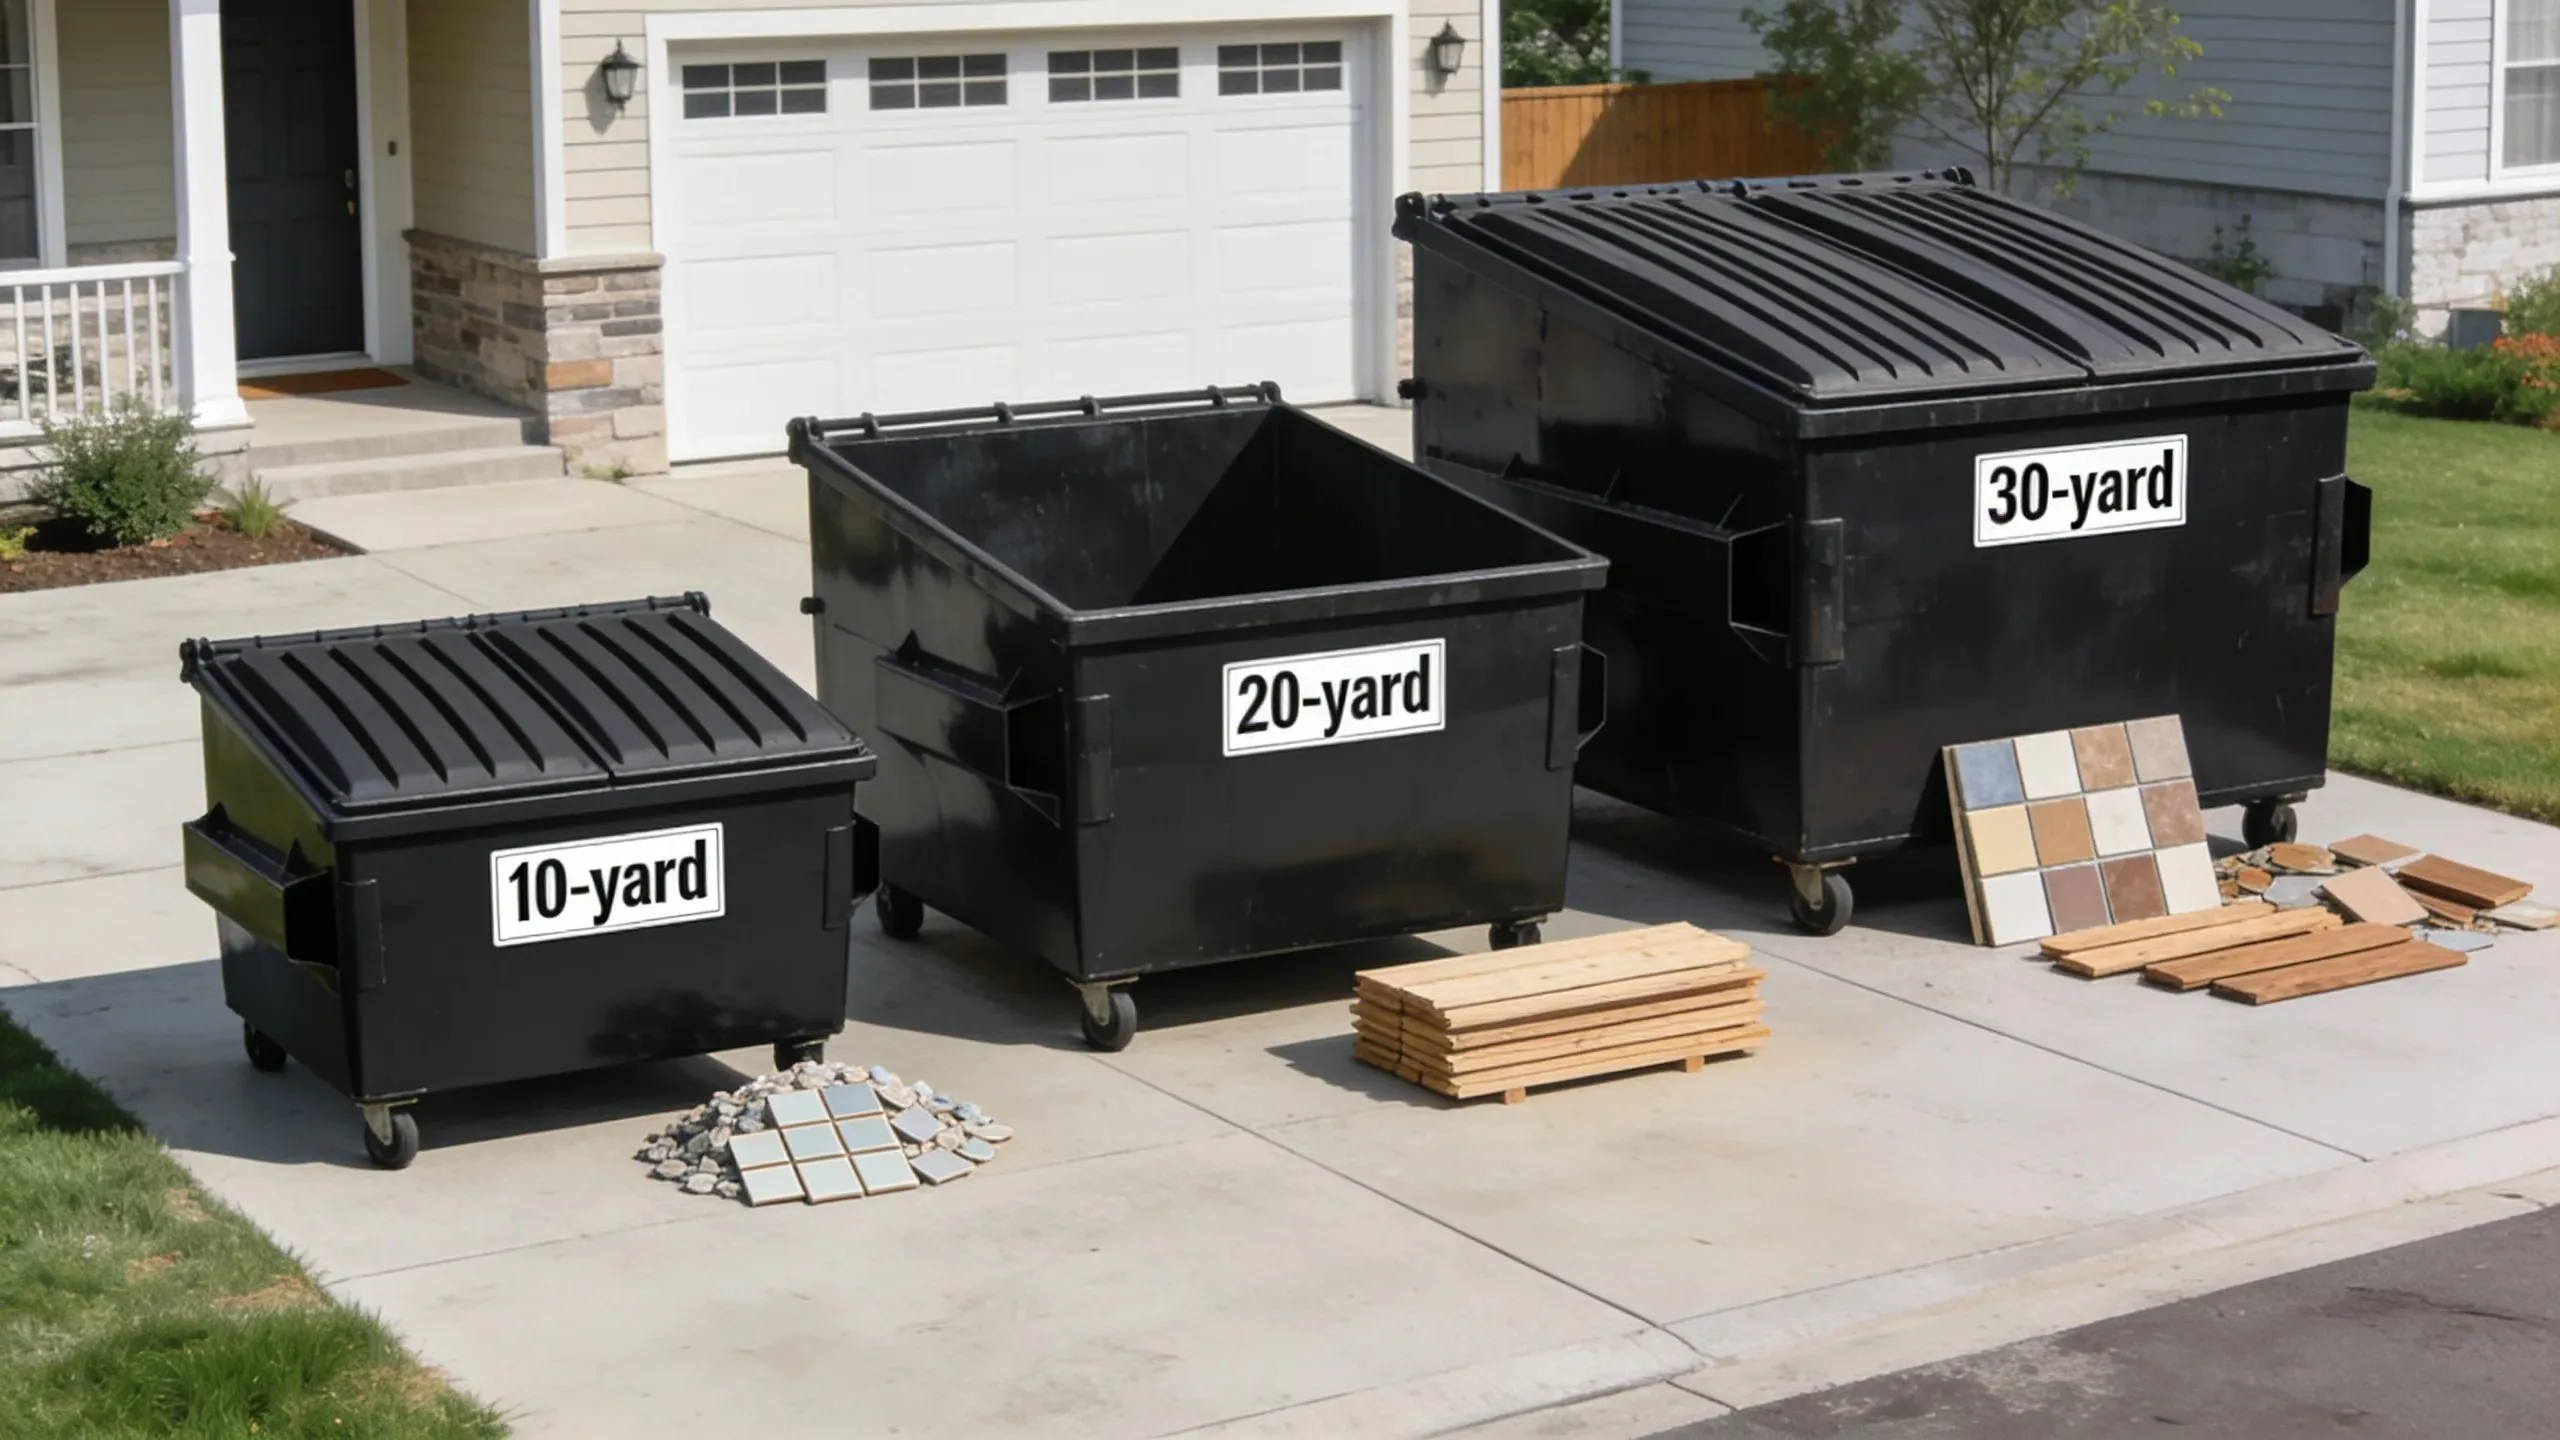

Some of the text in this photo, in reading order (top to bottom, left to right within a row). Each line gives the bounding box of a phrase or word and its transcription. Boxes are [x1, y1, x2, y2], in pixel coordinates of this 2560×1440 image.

[1988, 448, 2174, 531] 30-yard
[1237, 653, 1430, 738] 20-yard
[509, 838, 707, 927] 10-yard
